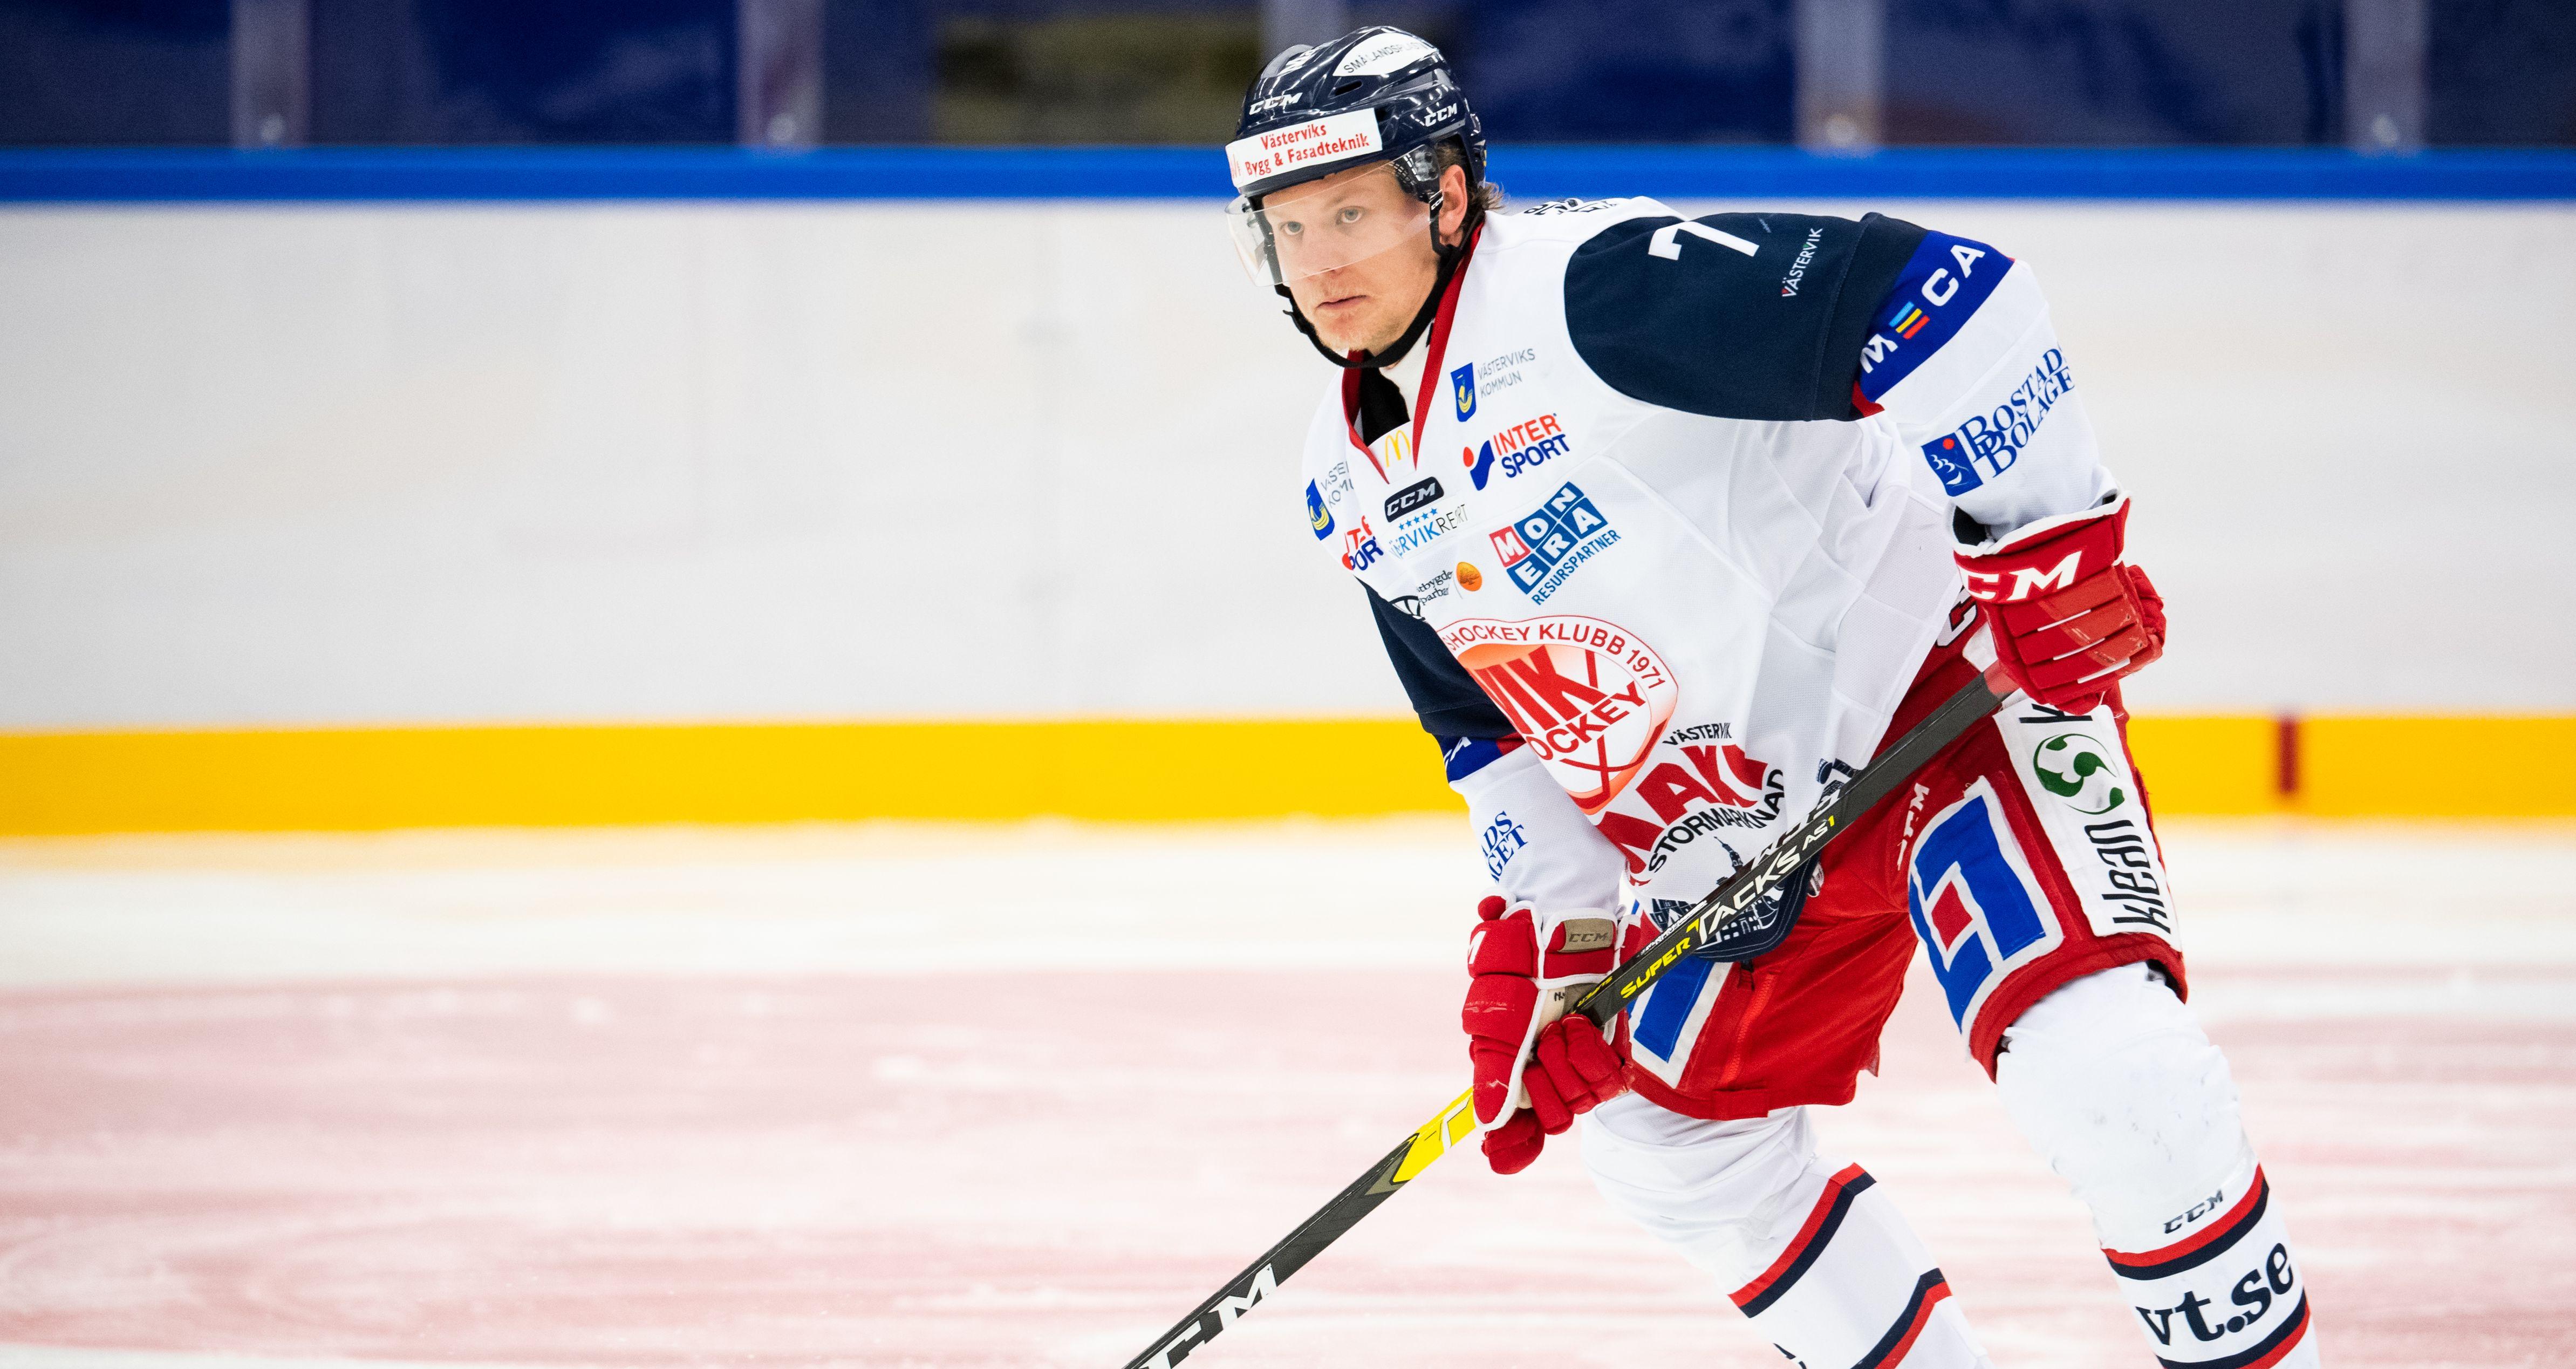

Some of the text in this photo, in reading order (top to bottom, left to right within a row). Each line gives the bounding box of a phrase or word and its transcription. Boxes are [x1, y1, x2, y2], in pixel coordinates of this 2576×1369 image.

[1249, 92, 1302, 115] CCM
[1425, 104, 1457, 127] CCM
[1245, 134, 1370, 176] Bygg & Fasadteknik
[1260, 124, 1327, 151] Västerviks
[1648, 222, 1760, 261] 7
[1782, 227, 1823, 297] VÄSTERVIK
[1477, 348, 1535, 380] VÄSTERVIKS
[1480, 370, 1522, 399] KOMMUN
[1493, 413, 1562, 456] INTER
[1976, 366, 2075, 478] BOLAGE
[1501, 434, 1570, 479] SPORT
[1386, 482, 1436, 516] CCM
[1532, 529, 1622, 606] RESURSPARTNER
[1958, 550, 2082, 601] CM
[1539, 623, 1626, 656] KLUBB
[1625, 649, 1666, 689] 1971
[1526, 680, 1646, 761] OCKEY
[1663, 722, 1733, 746] VÄSTERVIK
[1648, 769, 1785, 873] STORMARKNAD
[2083, 819, 2172, 935] klean
[1569, 931, 1609, 944] CCM
[1620, 937, 1691, 998] SUPER
[1699, 845, 1800, 945] TACKS
[2163, 1189, 2223, 1234] CCM
[1139, 1263, 1277, 1369] CM
[2135, 1242, 2294, 1346] vt.se
